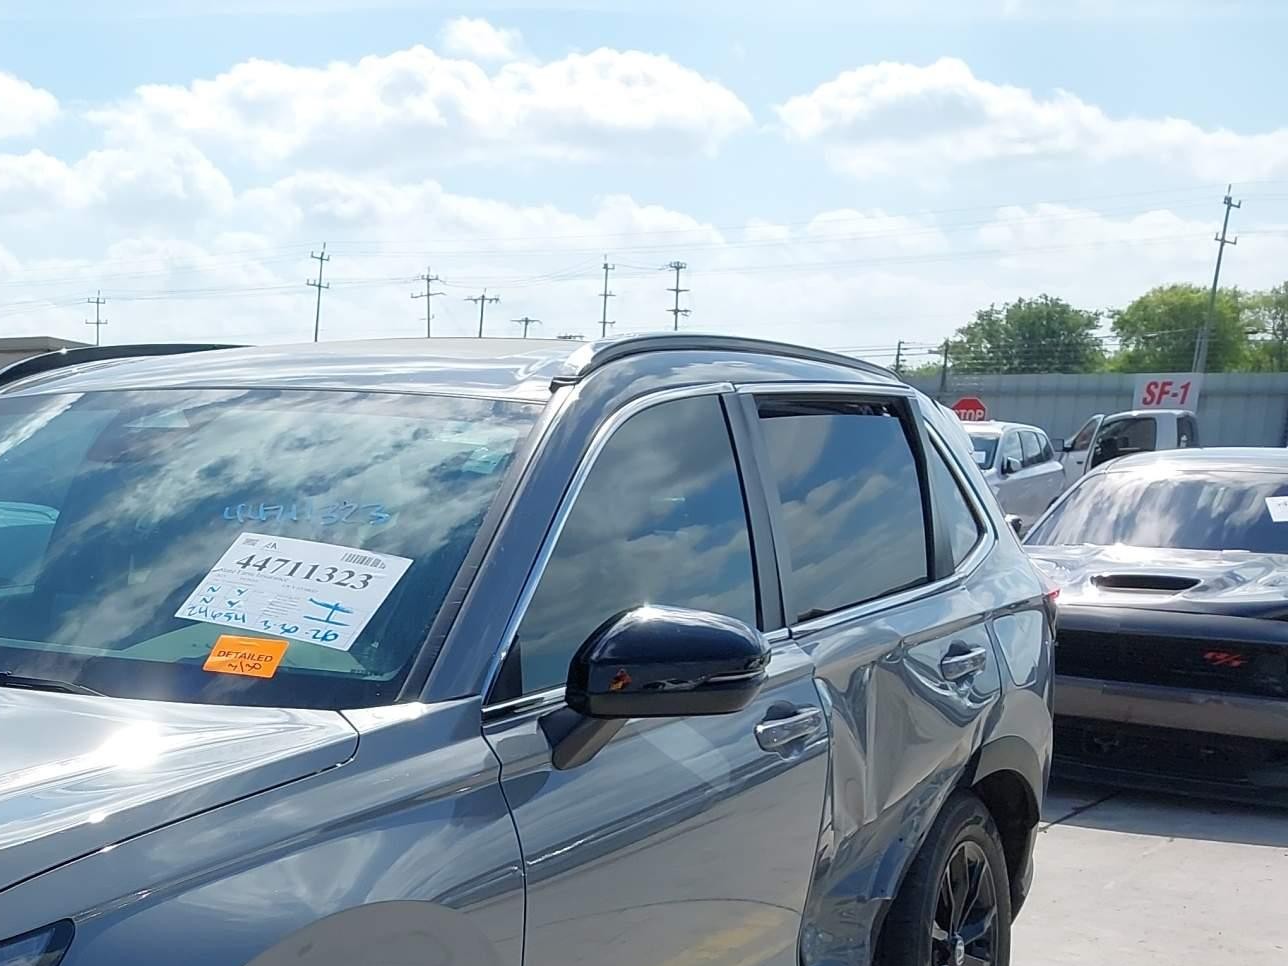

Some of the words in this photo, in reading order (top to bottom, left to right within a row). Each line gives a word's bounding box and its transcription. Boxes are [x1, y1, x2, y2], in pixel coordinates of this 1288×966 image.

[1142, 382, 1192, 405] SF-1
[235, 552, 374, 590] 44711323
[216, 650, 274, 664] DETAILED
